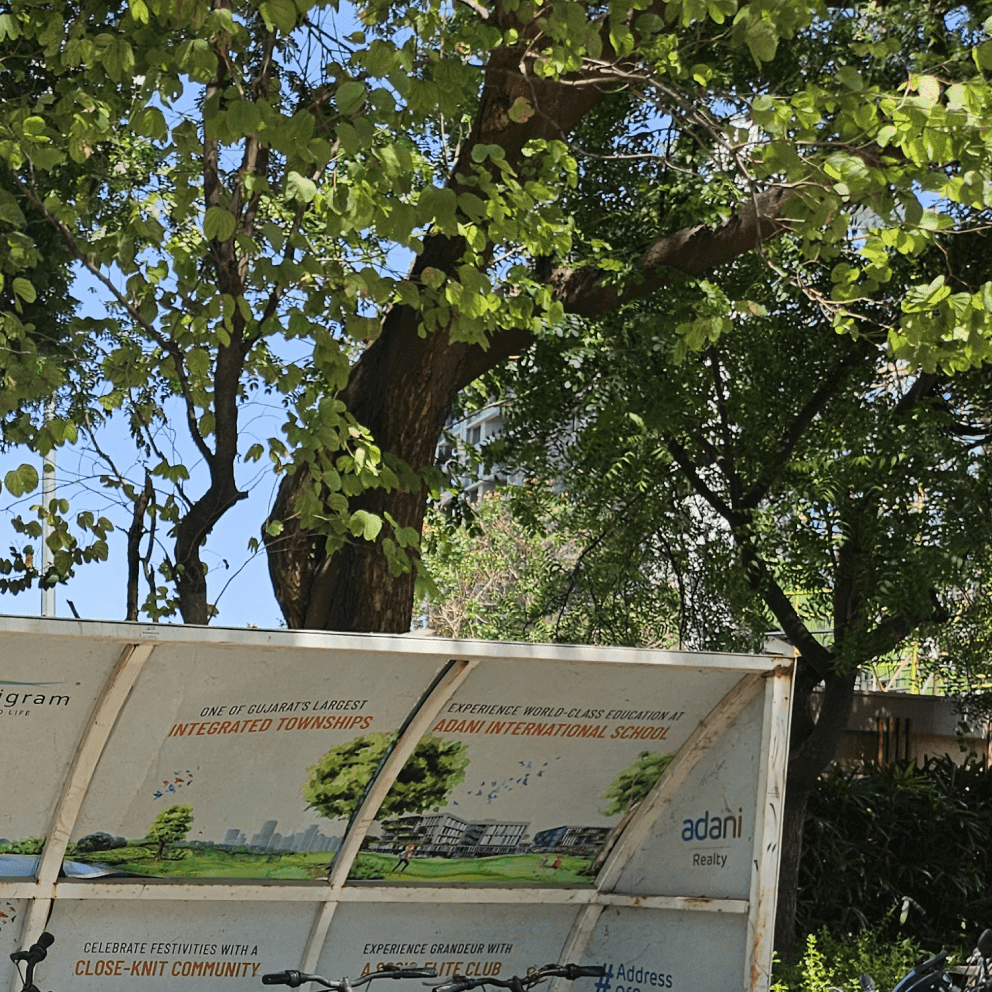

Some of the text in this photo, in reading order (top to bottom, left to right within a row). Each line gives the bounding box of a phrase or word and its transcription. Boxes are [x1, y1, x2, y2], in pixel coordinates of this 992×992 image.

[8, 709, 31, 717] LIFE
[200, 699, 369, 717] ONE OF GUJARAT'S LARGEST
[447, 702, 686, 722] EXPERIENCE WORLD-CLASS EDUCATION AT
[167, 715, 374, 738] INTEGRATED TOWNSHIPS
[432, 718, 671, 741] ADANI INTERNATIONAL SCHOOL
[681, 807, 743, 841] adani
[693, 852, 728, 868] Realty
[83, 942, 258, 956] CELEBRATE FESTIVITIES WITH A
[363, 943, 513, 955] EXPERIENCE GRANDEUR WITH
[74, 959, 261, 977] CLOSE-KNIT COMMUNITY
[361, 962, 371, 977] A
[465, 962, 502, 977] CLUB
